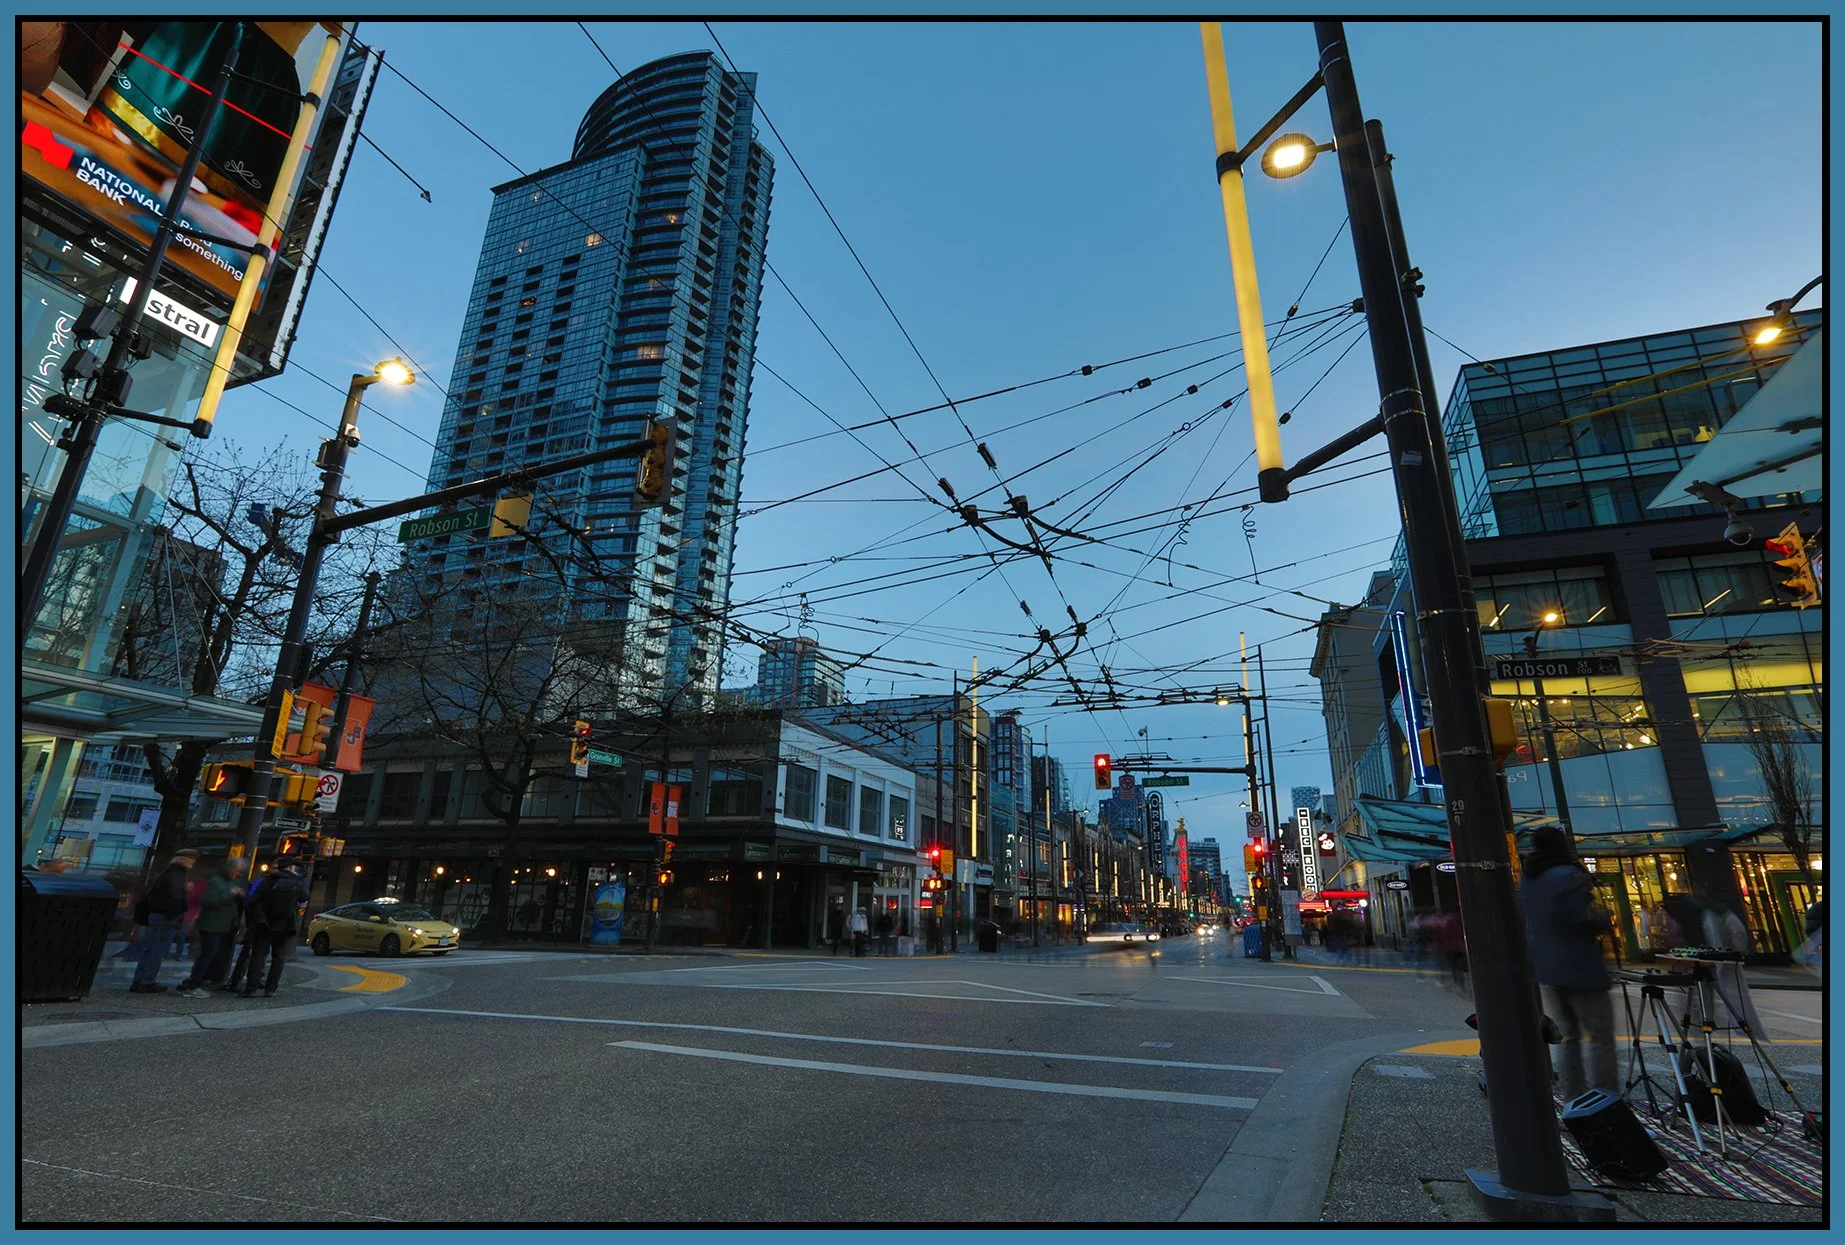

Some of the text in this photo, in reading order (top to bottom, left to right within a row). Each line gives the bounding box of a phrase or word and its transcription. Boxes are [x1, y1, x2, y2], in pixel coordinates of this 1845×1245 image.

[75, 168, 127, 206] BANK
[81, 157, 164, 217] NATIONAL
[175, 232, 245, 282] something
[147, 298, 212, 341] stral
[409, 512, 480, 538] Robson St
[1502, 660, 1589, 678] Robson St
[1576, 667, 1593, 676] 700
[589, 750, 621, 765] Granville St
[1147, 778, 1185, 787] Robson St
[1452, 799, 1465, 811] 29
[1151, 798, 1163, 875] ORPHEUM
[1301, 819, 1310, 846] REC
[1178, 836, 1189, 893] VOGUE
